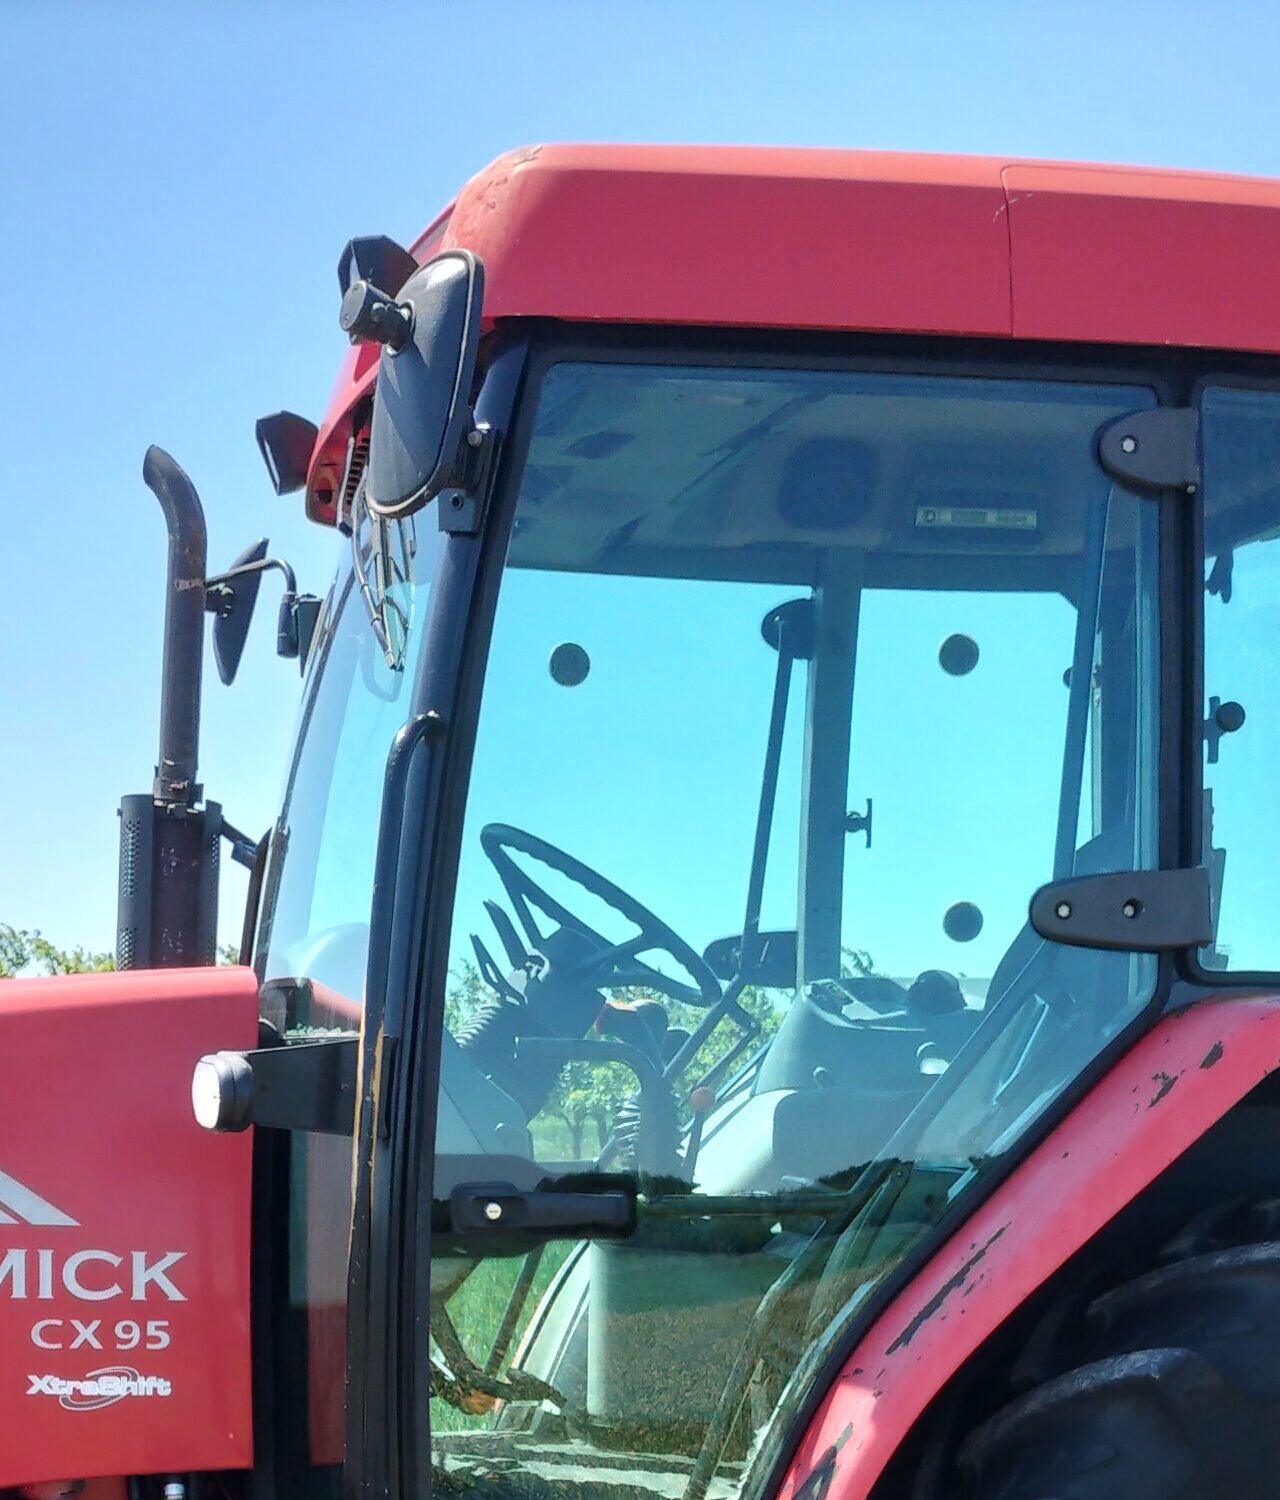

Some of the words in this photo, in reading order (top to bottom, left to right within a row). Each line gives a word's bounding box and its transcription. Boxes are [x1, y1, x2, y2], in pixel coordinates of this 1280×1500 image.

[31, 1318, 103, 1350] CX
[115, 1320, 170, 1350] 95
[25, 1374, 172, 1397] XtraShift
